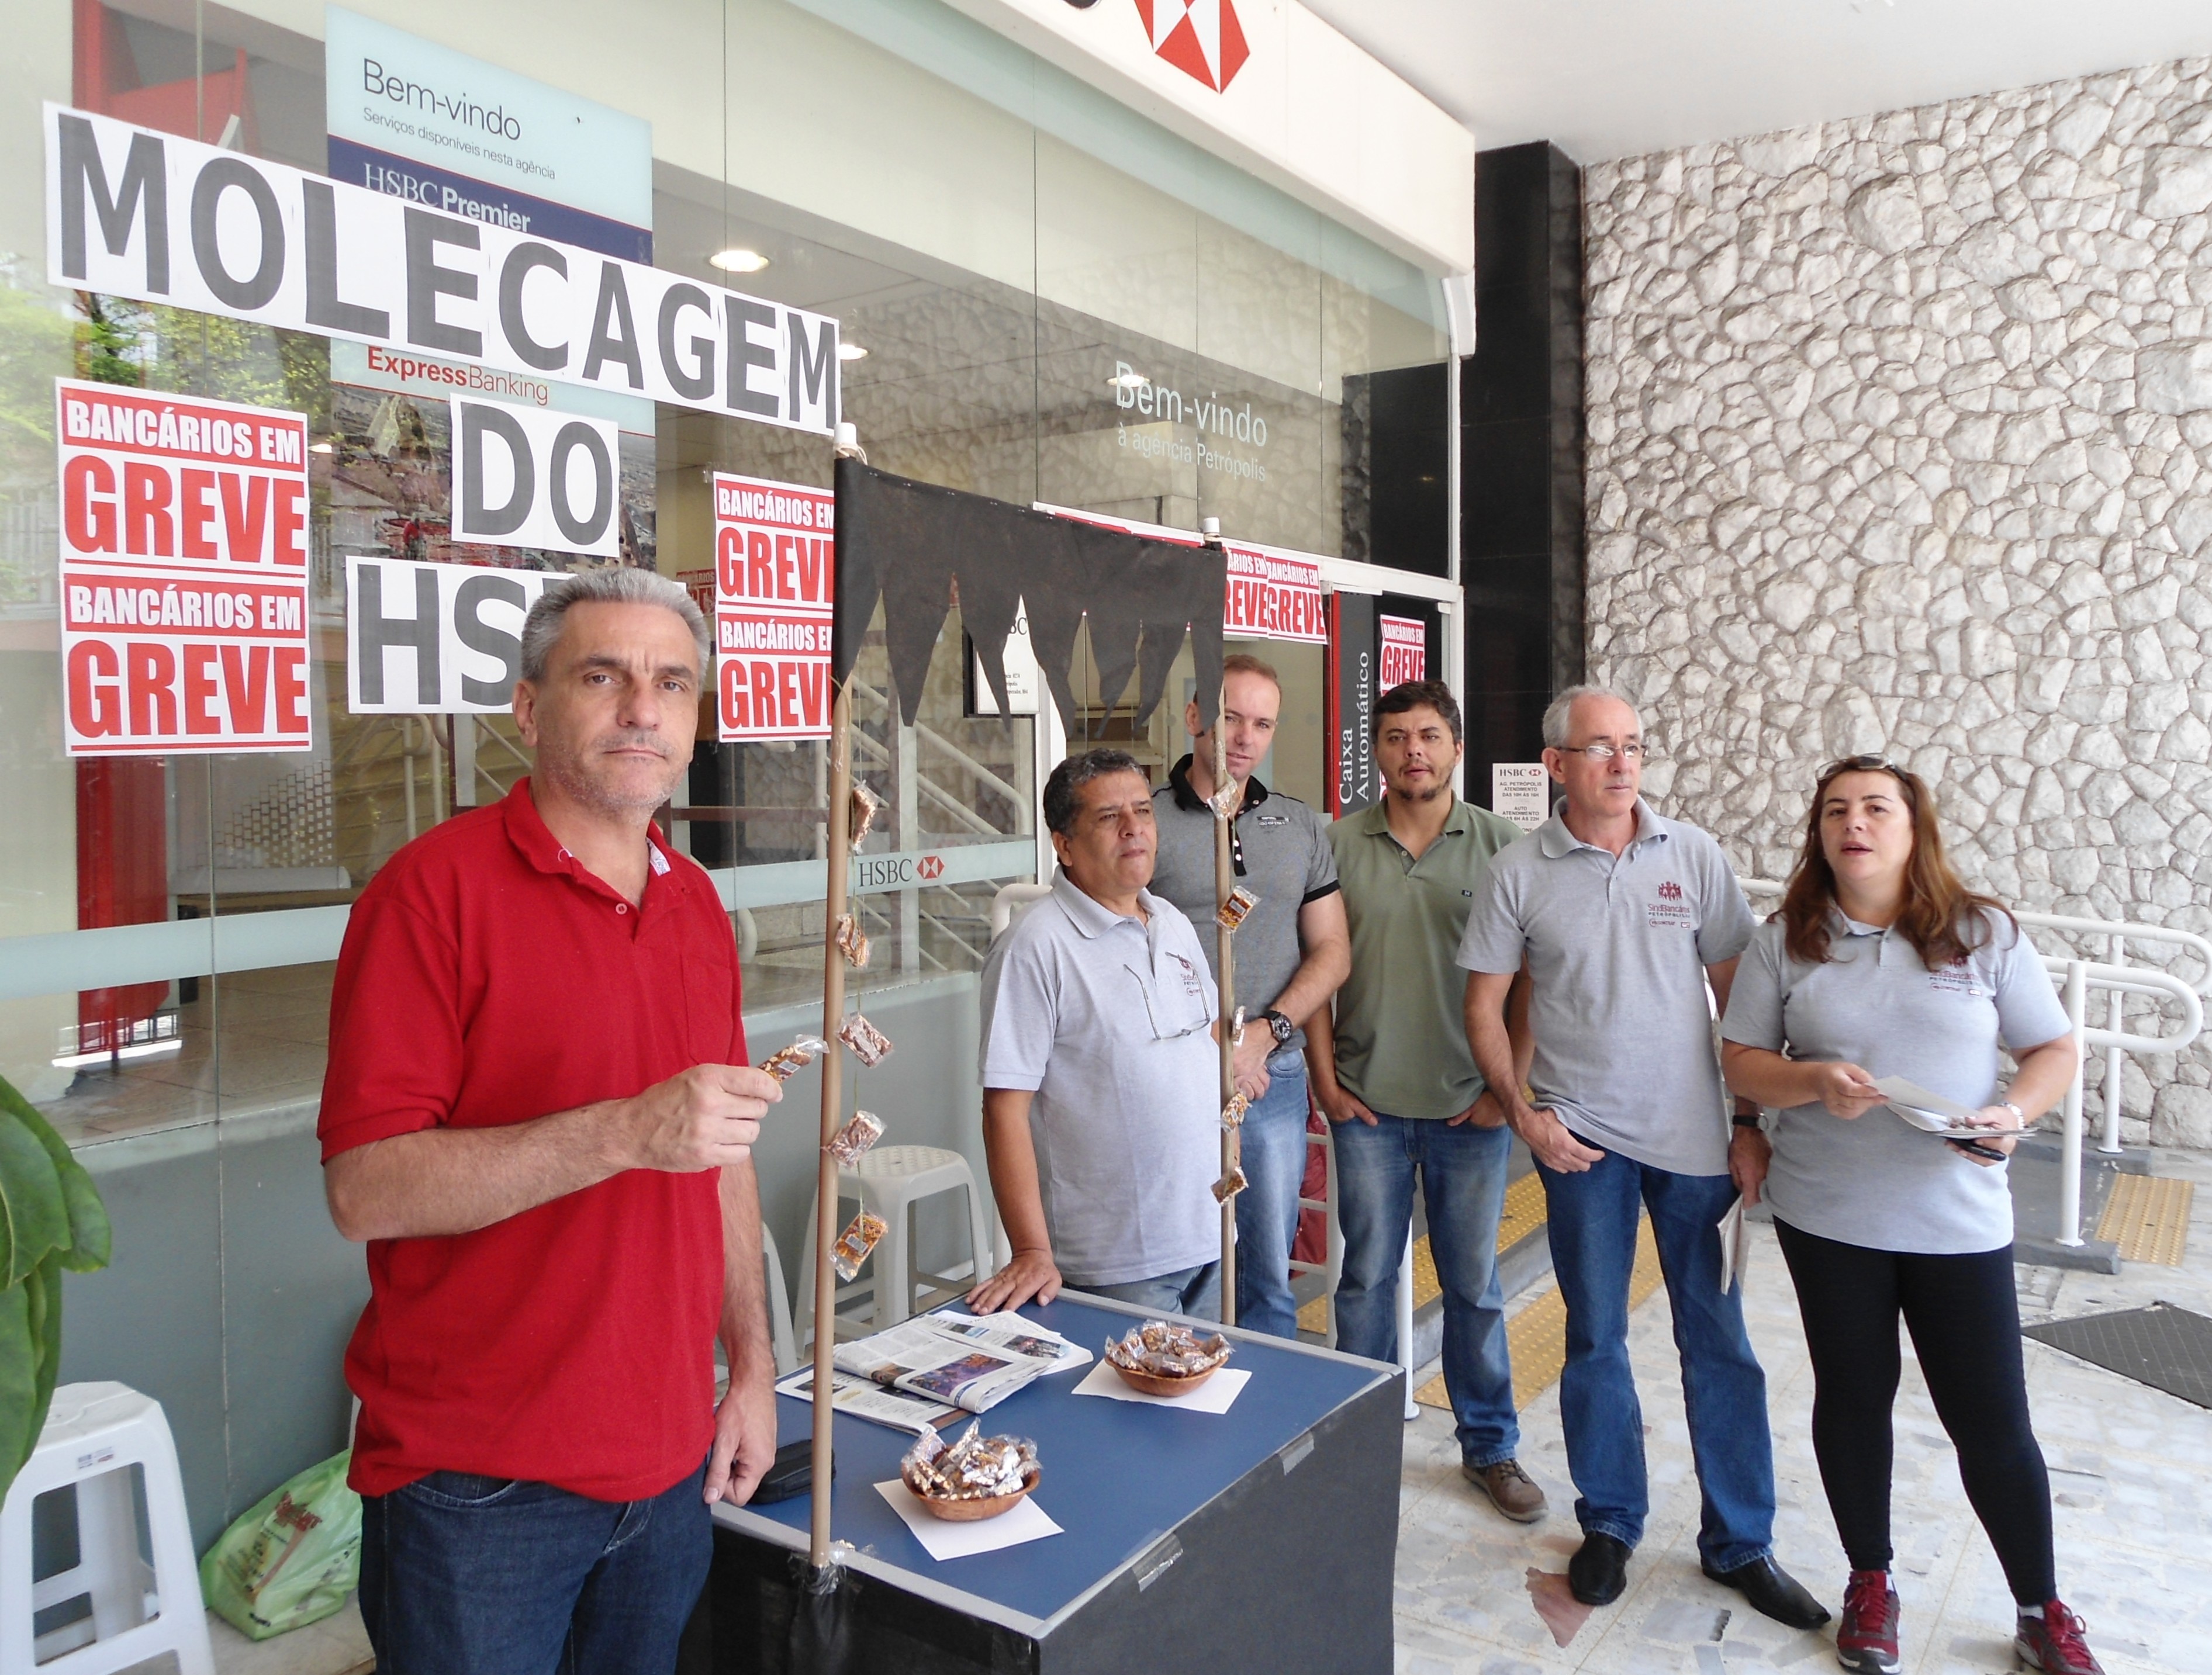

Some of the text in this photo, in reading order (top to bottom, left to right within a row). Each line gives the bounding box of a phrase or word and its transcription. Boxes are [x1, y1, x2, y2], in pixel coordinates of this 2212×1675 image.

[363, 57, 521, 141] Bem-vindo
[363, 107, 556, 179] Serviços disponíveis nesta agência
[363, 162, 531, 233] HSBC Premier
[58, 113, 838, 430] MOLECAGEM
[66, 399, 300, 465] BANCÁRIOS EM
[1116, 360, 1267, 447] Bem-vindo
[460, 400, 613, 546] DO
[1118, 422, 1266, 482] à agência Petrópolis
[64, 454, 305, 566] GREVE
[718, 487, 813, 528] BANCÁRIOS
[1227, 548, 1267, 576] ÁRIOS EM
[1266, 561, 1319, 587] BANCÁRIOS EM
[69, 584, 300, 631] BANCÁRIOS EM
[357, 564, 577, 707] HS
[721, 618, 815, 651] BANCÁRIOS
[1267, 587, 1325, 635] GREVE
[1383, 622, 1423, 644] BANCÁRIOS EM
[67, 639, 309, 738] GREVE
[720, 659, 832, 729] GREV
[1382, 645, 1424, 685] GREVE
[1356, 651, 1369, 802] Automático
[1339, 727, 1353, 805] Caixa
[1499, 768, 1527, 777] HSBC
[858, 858, 913, 887] HSBC
